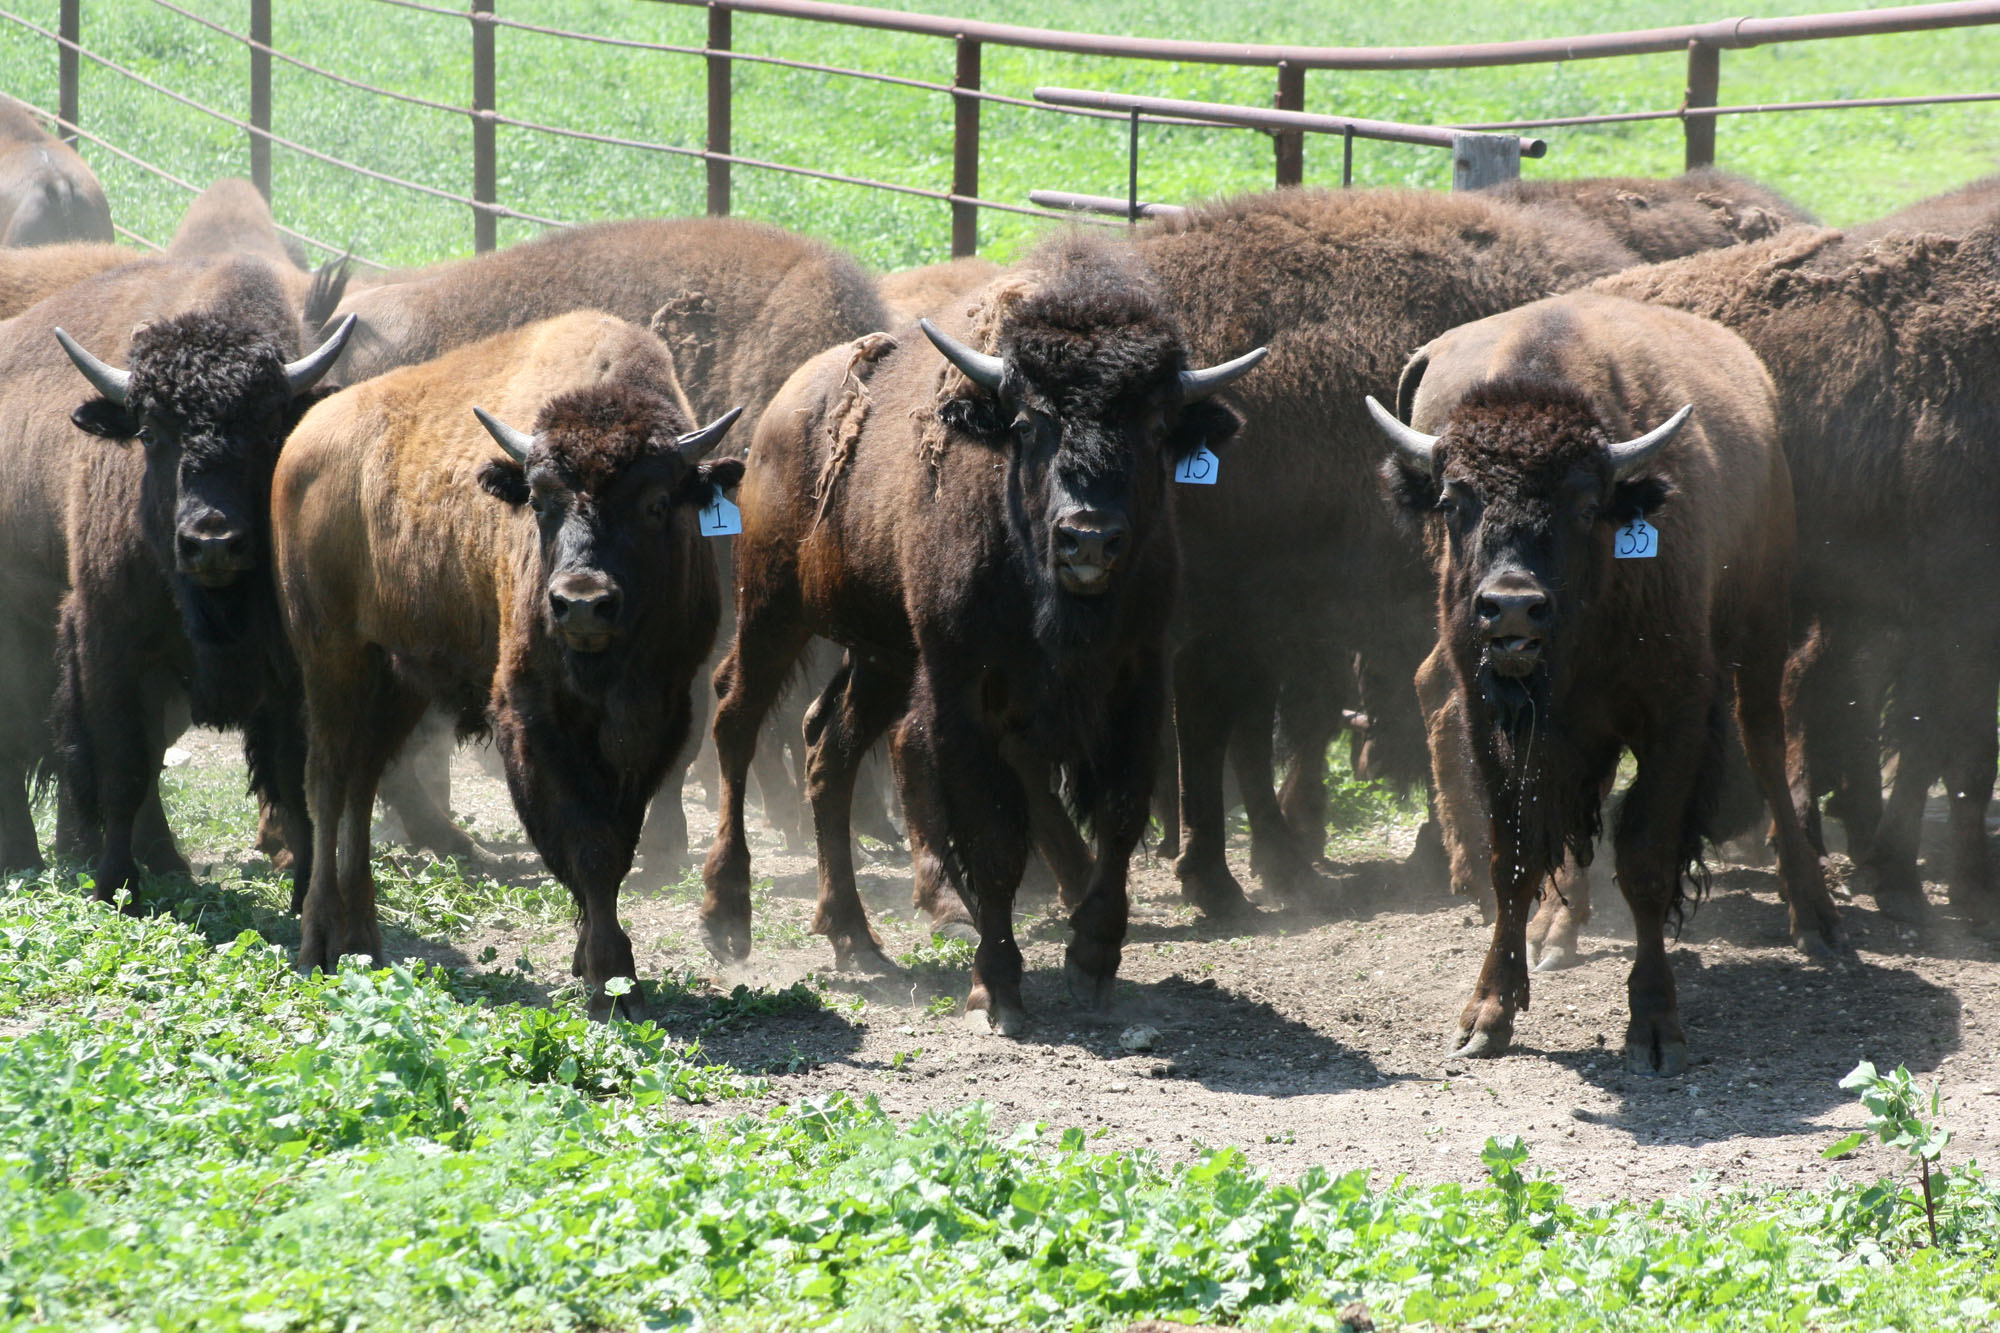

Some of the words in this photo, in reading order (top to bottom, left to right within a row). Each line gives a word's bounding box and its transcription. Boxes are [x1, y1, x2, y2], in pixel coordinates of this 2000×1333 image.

[1184, 451, 1211, 479] 15
[712, 503, 728, 529] 1
[1620, 523, 1650, 555] 33
